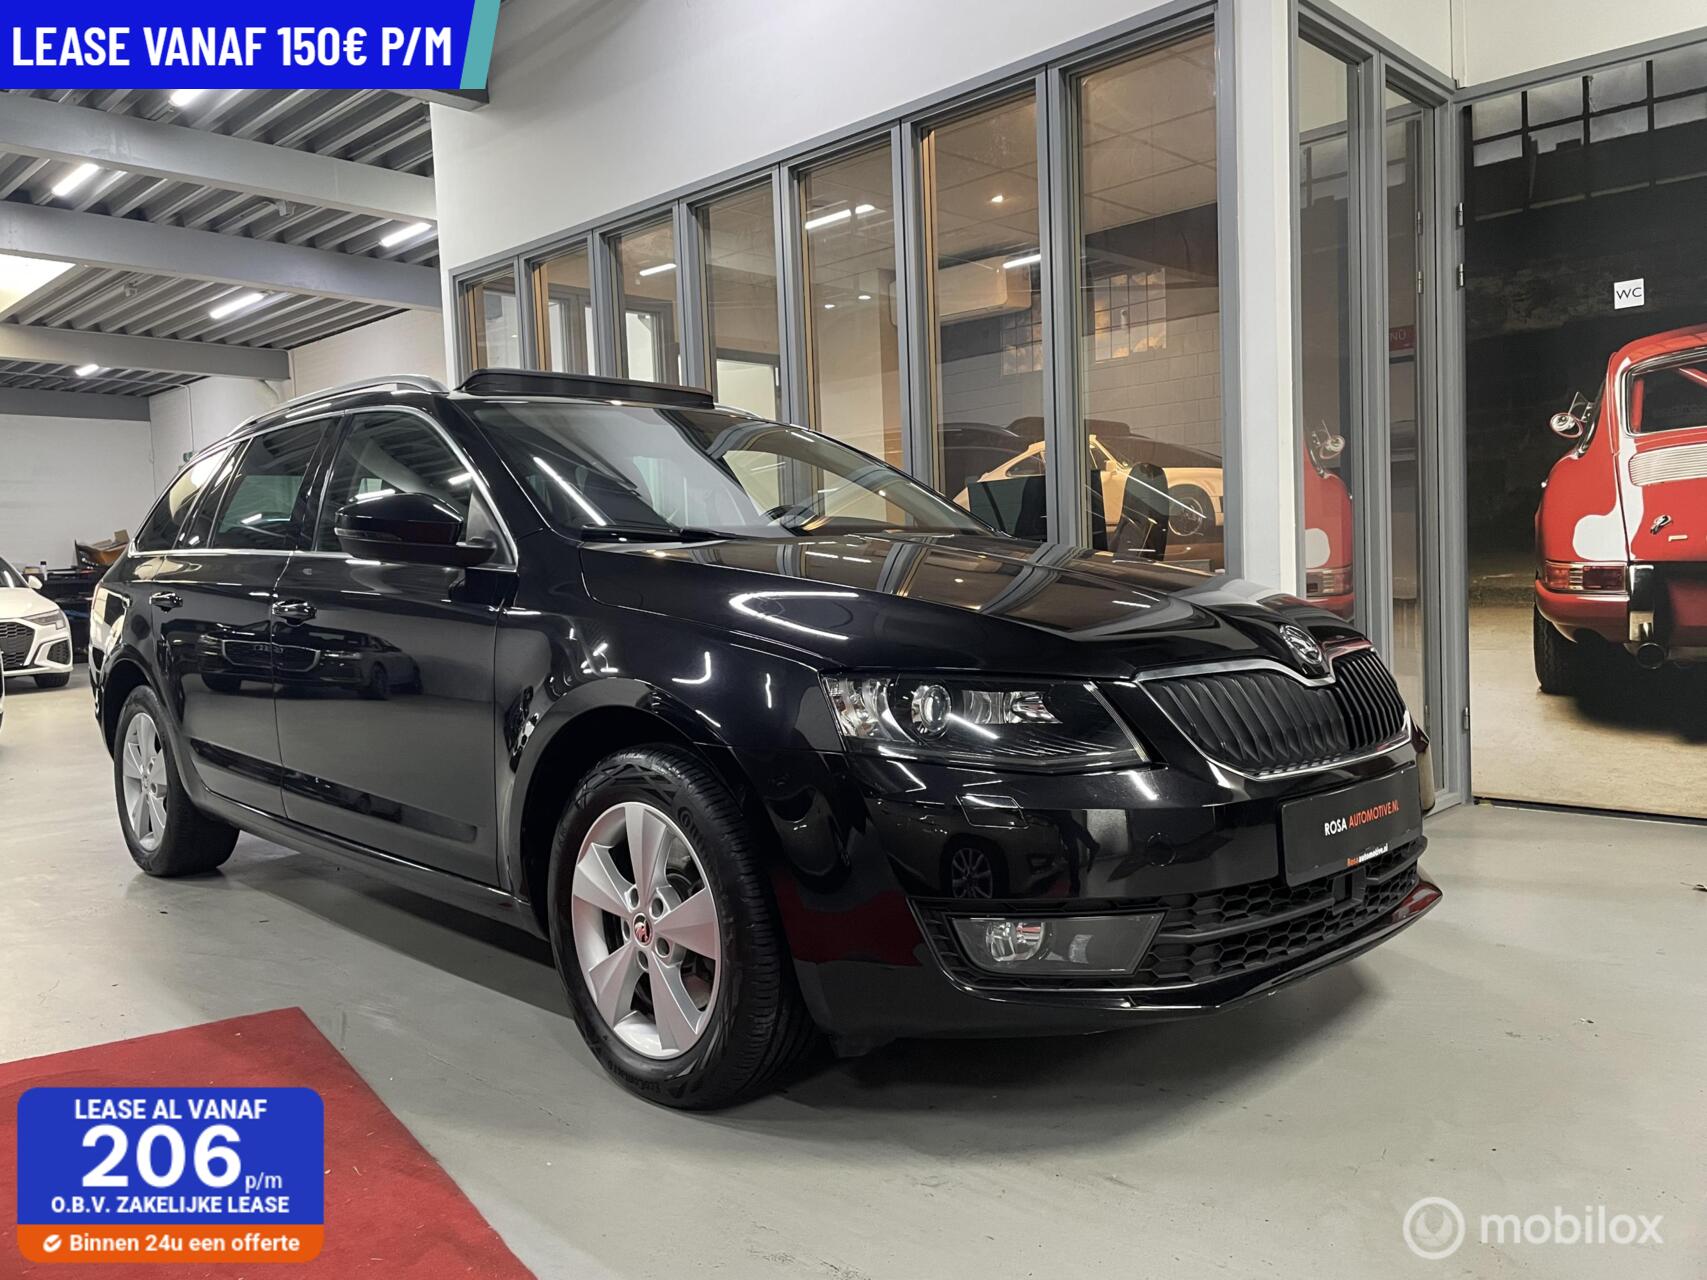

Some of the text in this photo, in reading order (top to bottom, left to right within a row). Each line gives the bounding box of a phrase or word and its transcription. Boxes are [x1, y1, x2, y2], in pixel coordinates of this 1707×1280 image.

[1616, 287, 1642, 300] WC
[1324, 800, 1399, 836] ROSA AUTOMOTIVE.NL
